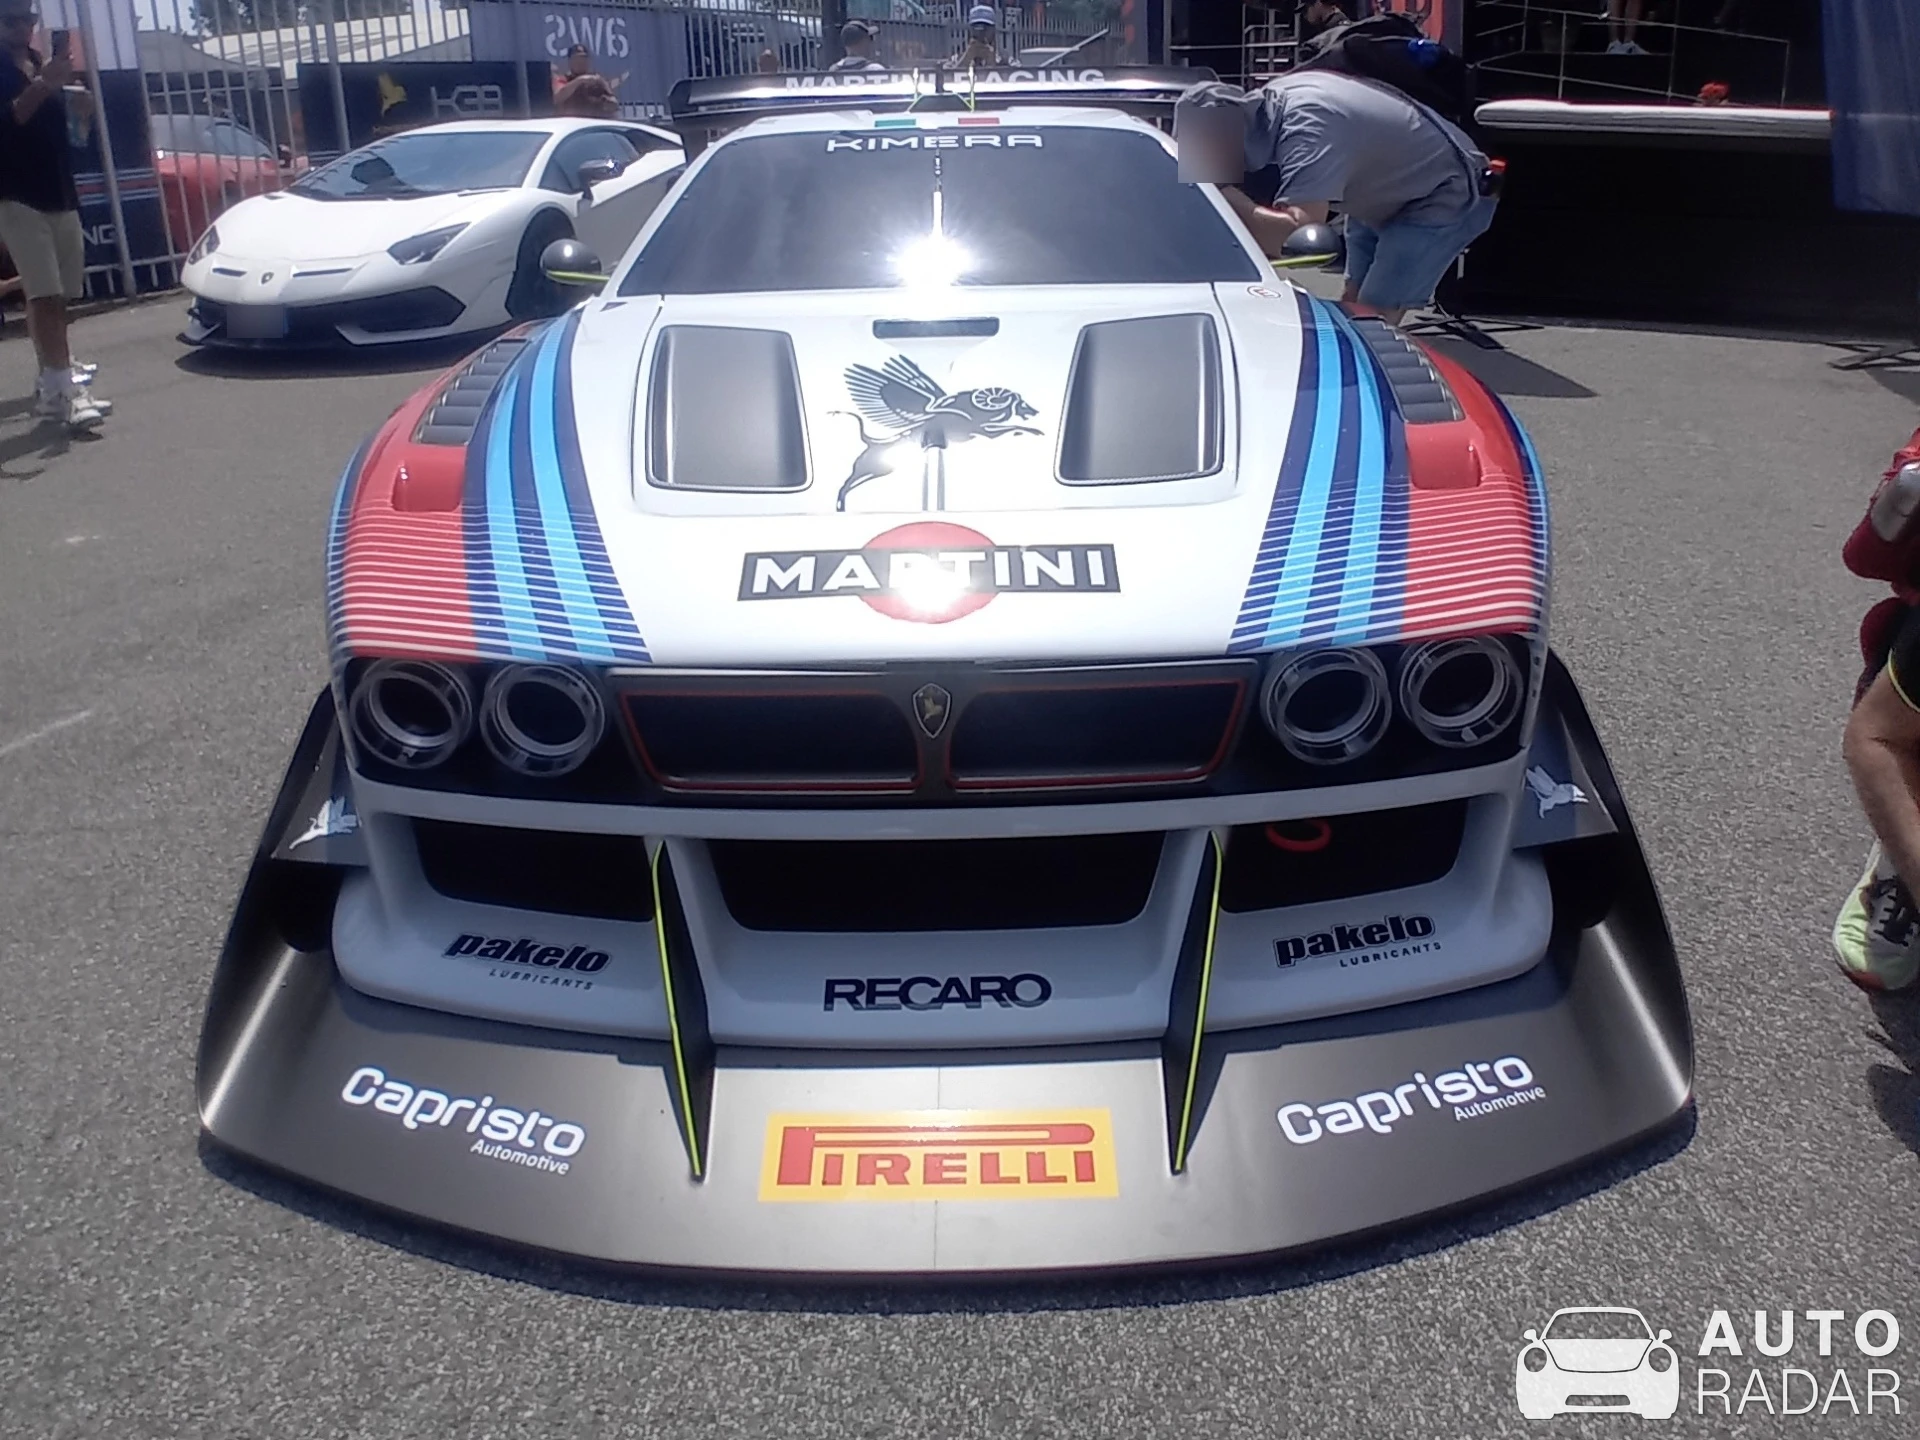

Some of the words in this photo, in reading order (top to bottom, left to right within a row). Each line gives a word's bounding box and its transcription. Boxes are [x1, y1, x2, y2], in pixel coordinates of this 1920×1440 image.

[827, 134, 1043, 151] KIMERA
[752, 549, 1106, 594] MARTINI
[444, 934, 610, 972] pakelo
[1275, 915, 1434, 966] pakelo
[1339, 942, 1442, 968] LUBRICANTS
[489, 968, 594, 990] LUBRICANTS
[823, 973, 1052, 1011] RECARO
[342, 1067, 586, 1157] Capristo
[1277, 1056, 1534, 1144] Capristo
[1453, 1085, 1547, 1122] Automotive
[470, 1138, 570, 1176] Automotive
[777, 1122, 1096, 1186] PIRELLI
